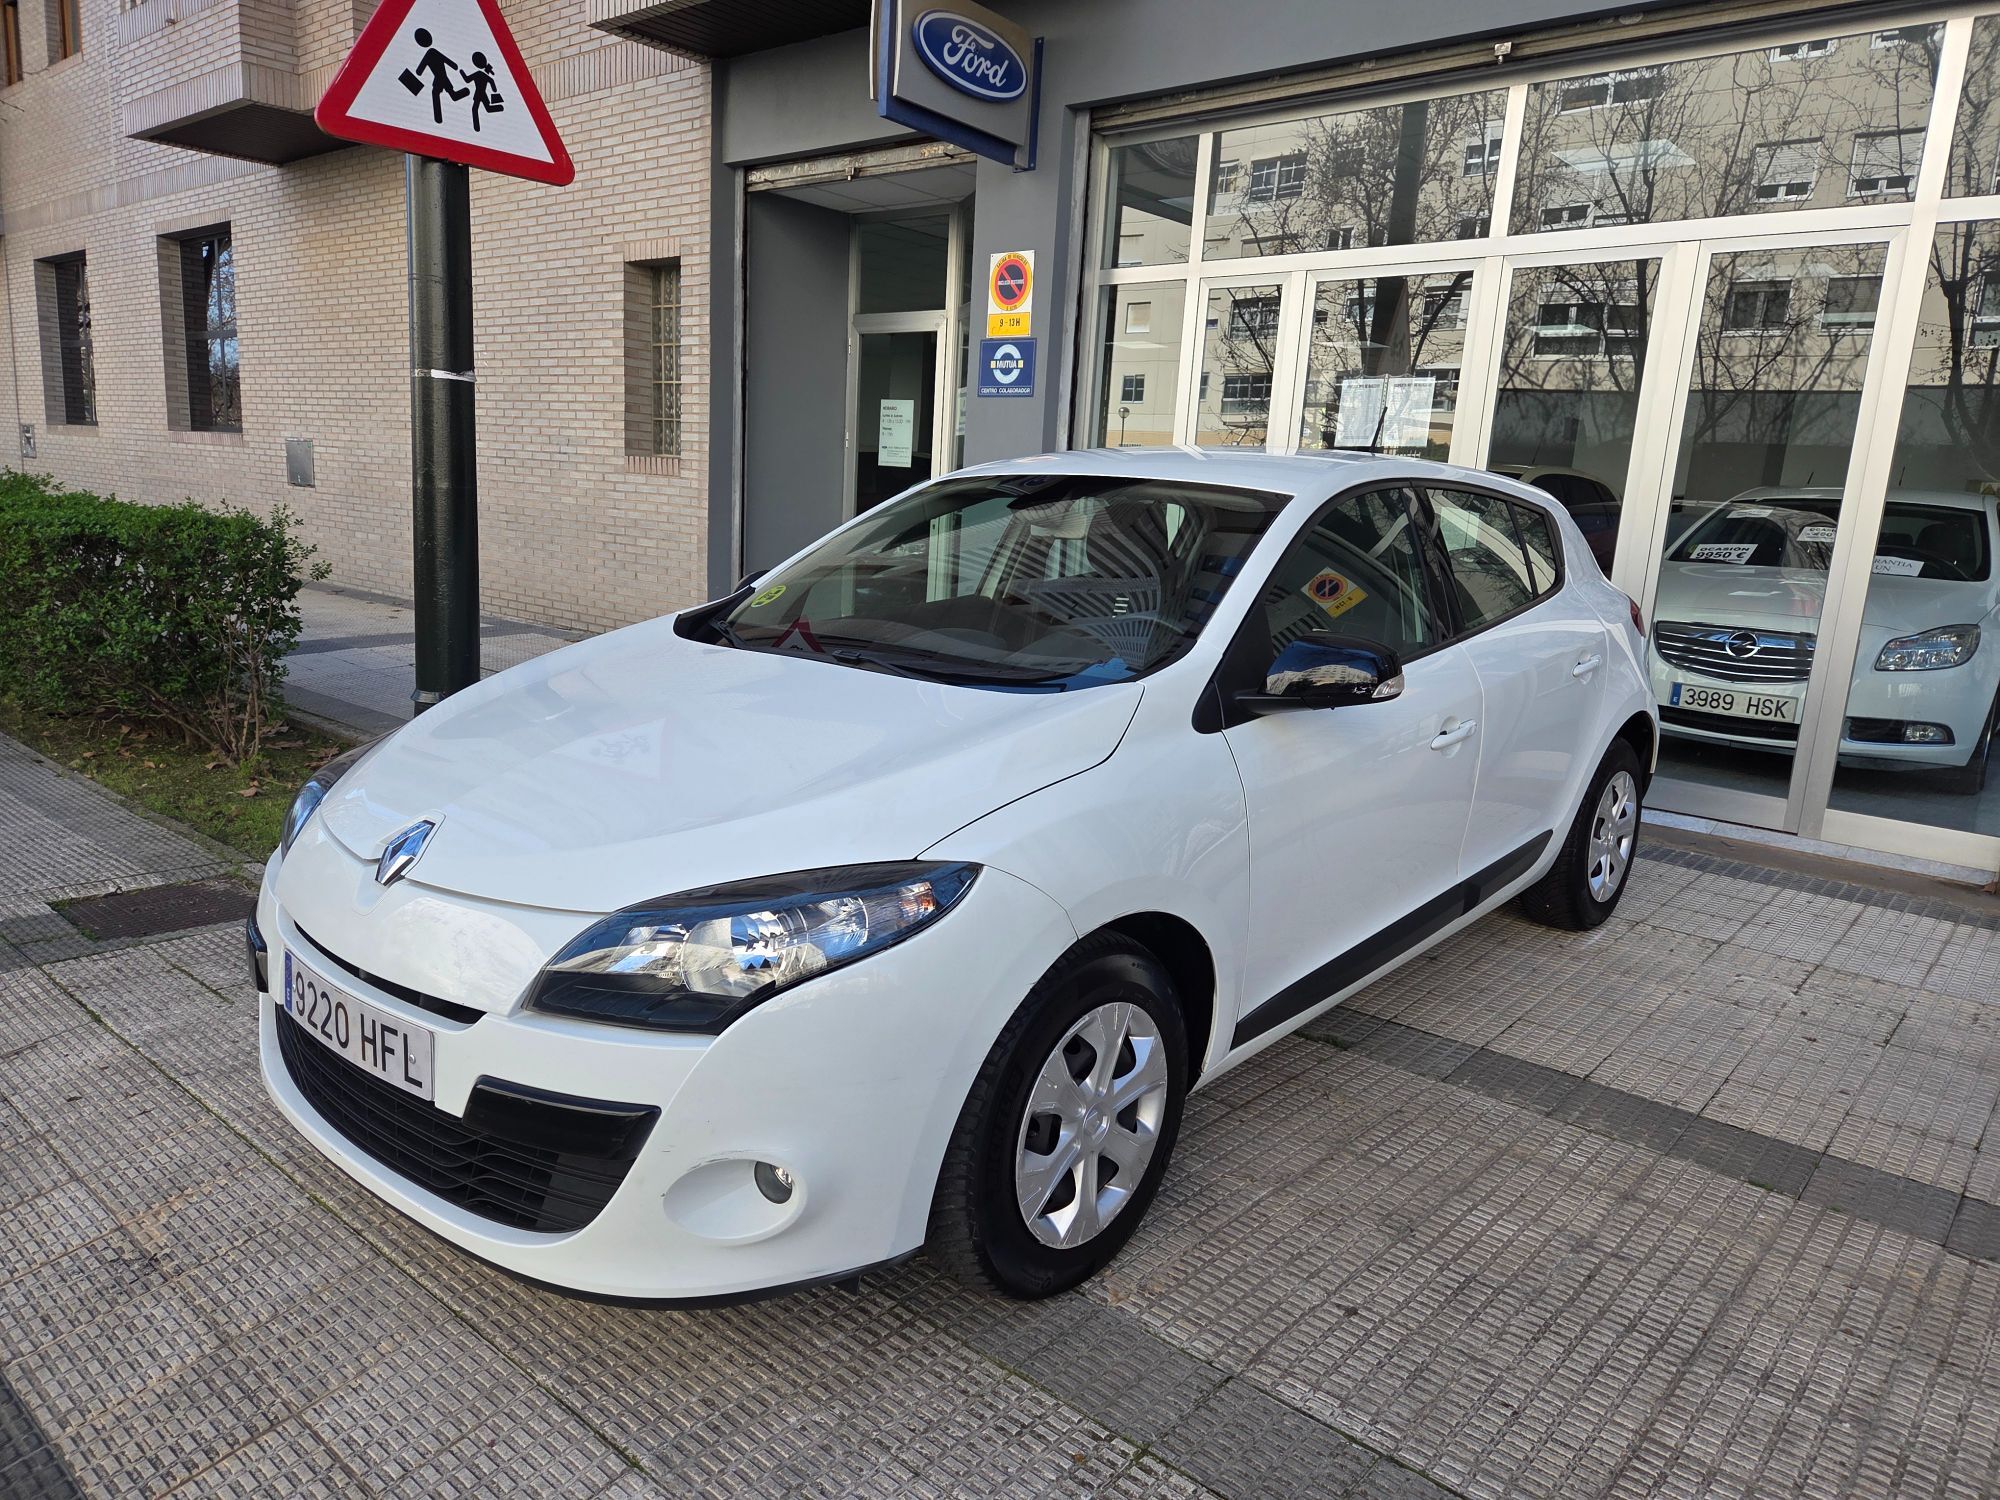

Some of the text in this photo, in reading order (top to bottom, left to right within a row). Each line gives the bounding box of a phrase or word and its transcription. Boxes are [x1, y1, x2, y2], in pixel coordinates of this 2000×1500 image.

[943, 25, 1009, 87] Ford
[996, 360, 1017, 369] MUTUA
[1695, 551, 1732, 560] 9950
[1684, 688, 1735, 711] 3989
[1746, 696, 1790, 719] HSK
[295, 970, 350, 1050] 9220
[360, 1012, 423, 1089] HFL
